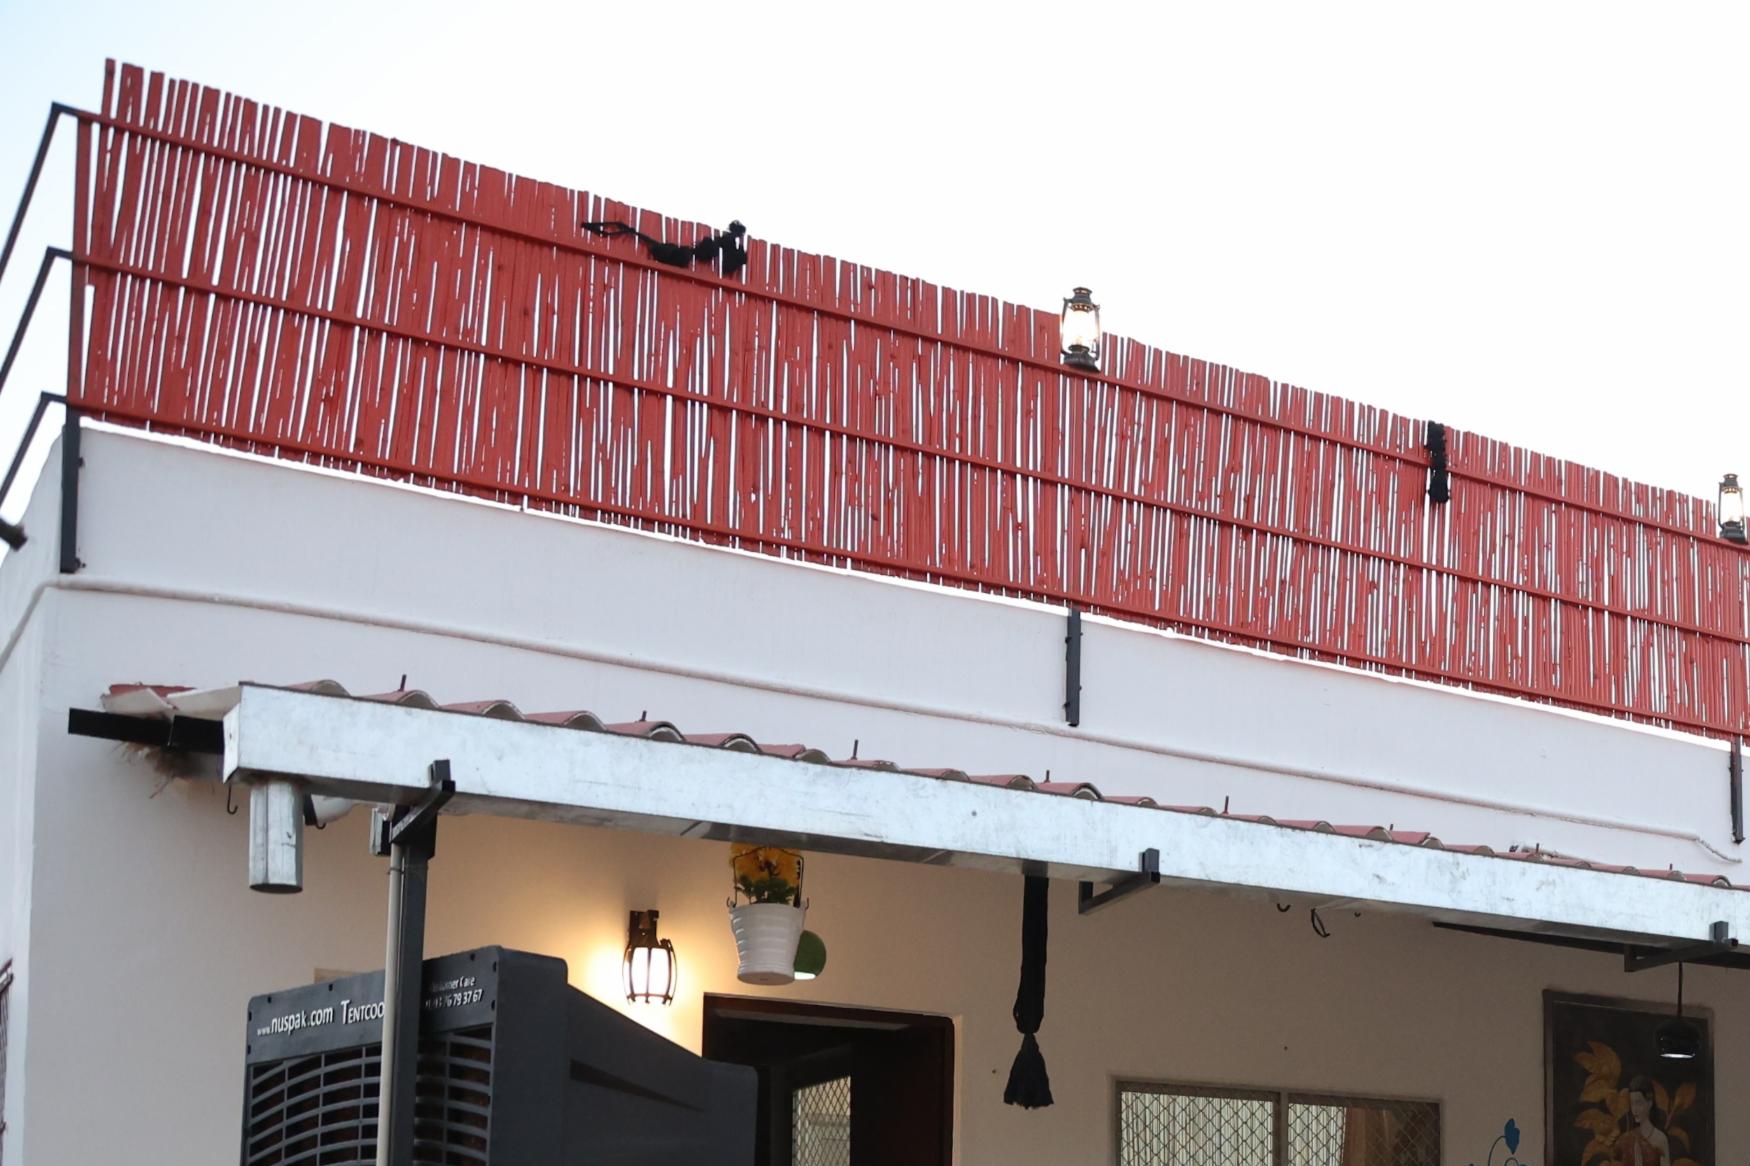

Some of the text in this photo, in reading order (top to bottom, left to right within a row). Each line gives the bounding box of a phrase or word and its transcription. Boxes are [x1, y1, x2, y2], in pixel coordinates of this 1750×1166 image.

[453, 992, 462, 1006] 79
[463, 990, 472, 1005] 37
[473, 988, 483, 1003] 67
[257, 1006, 334, 1036] www.nuspak.com
